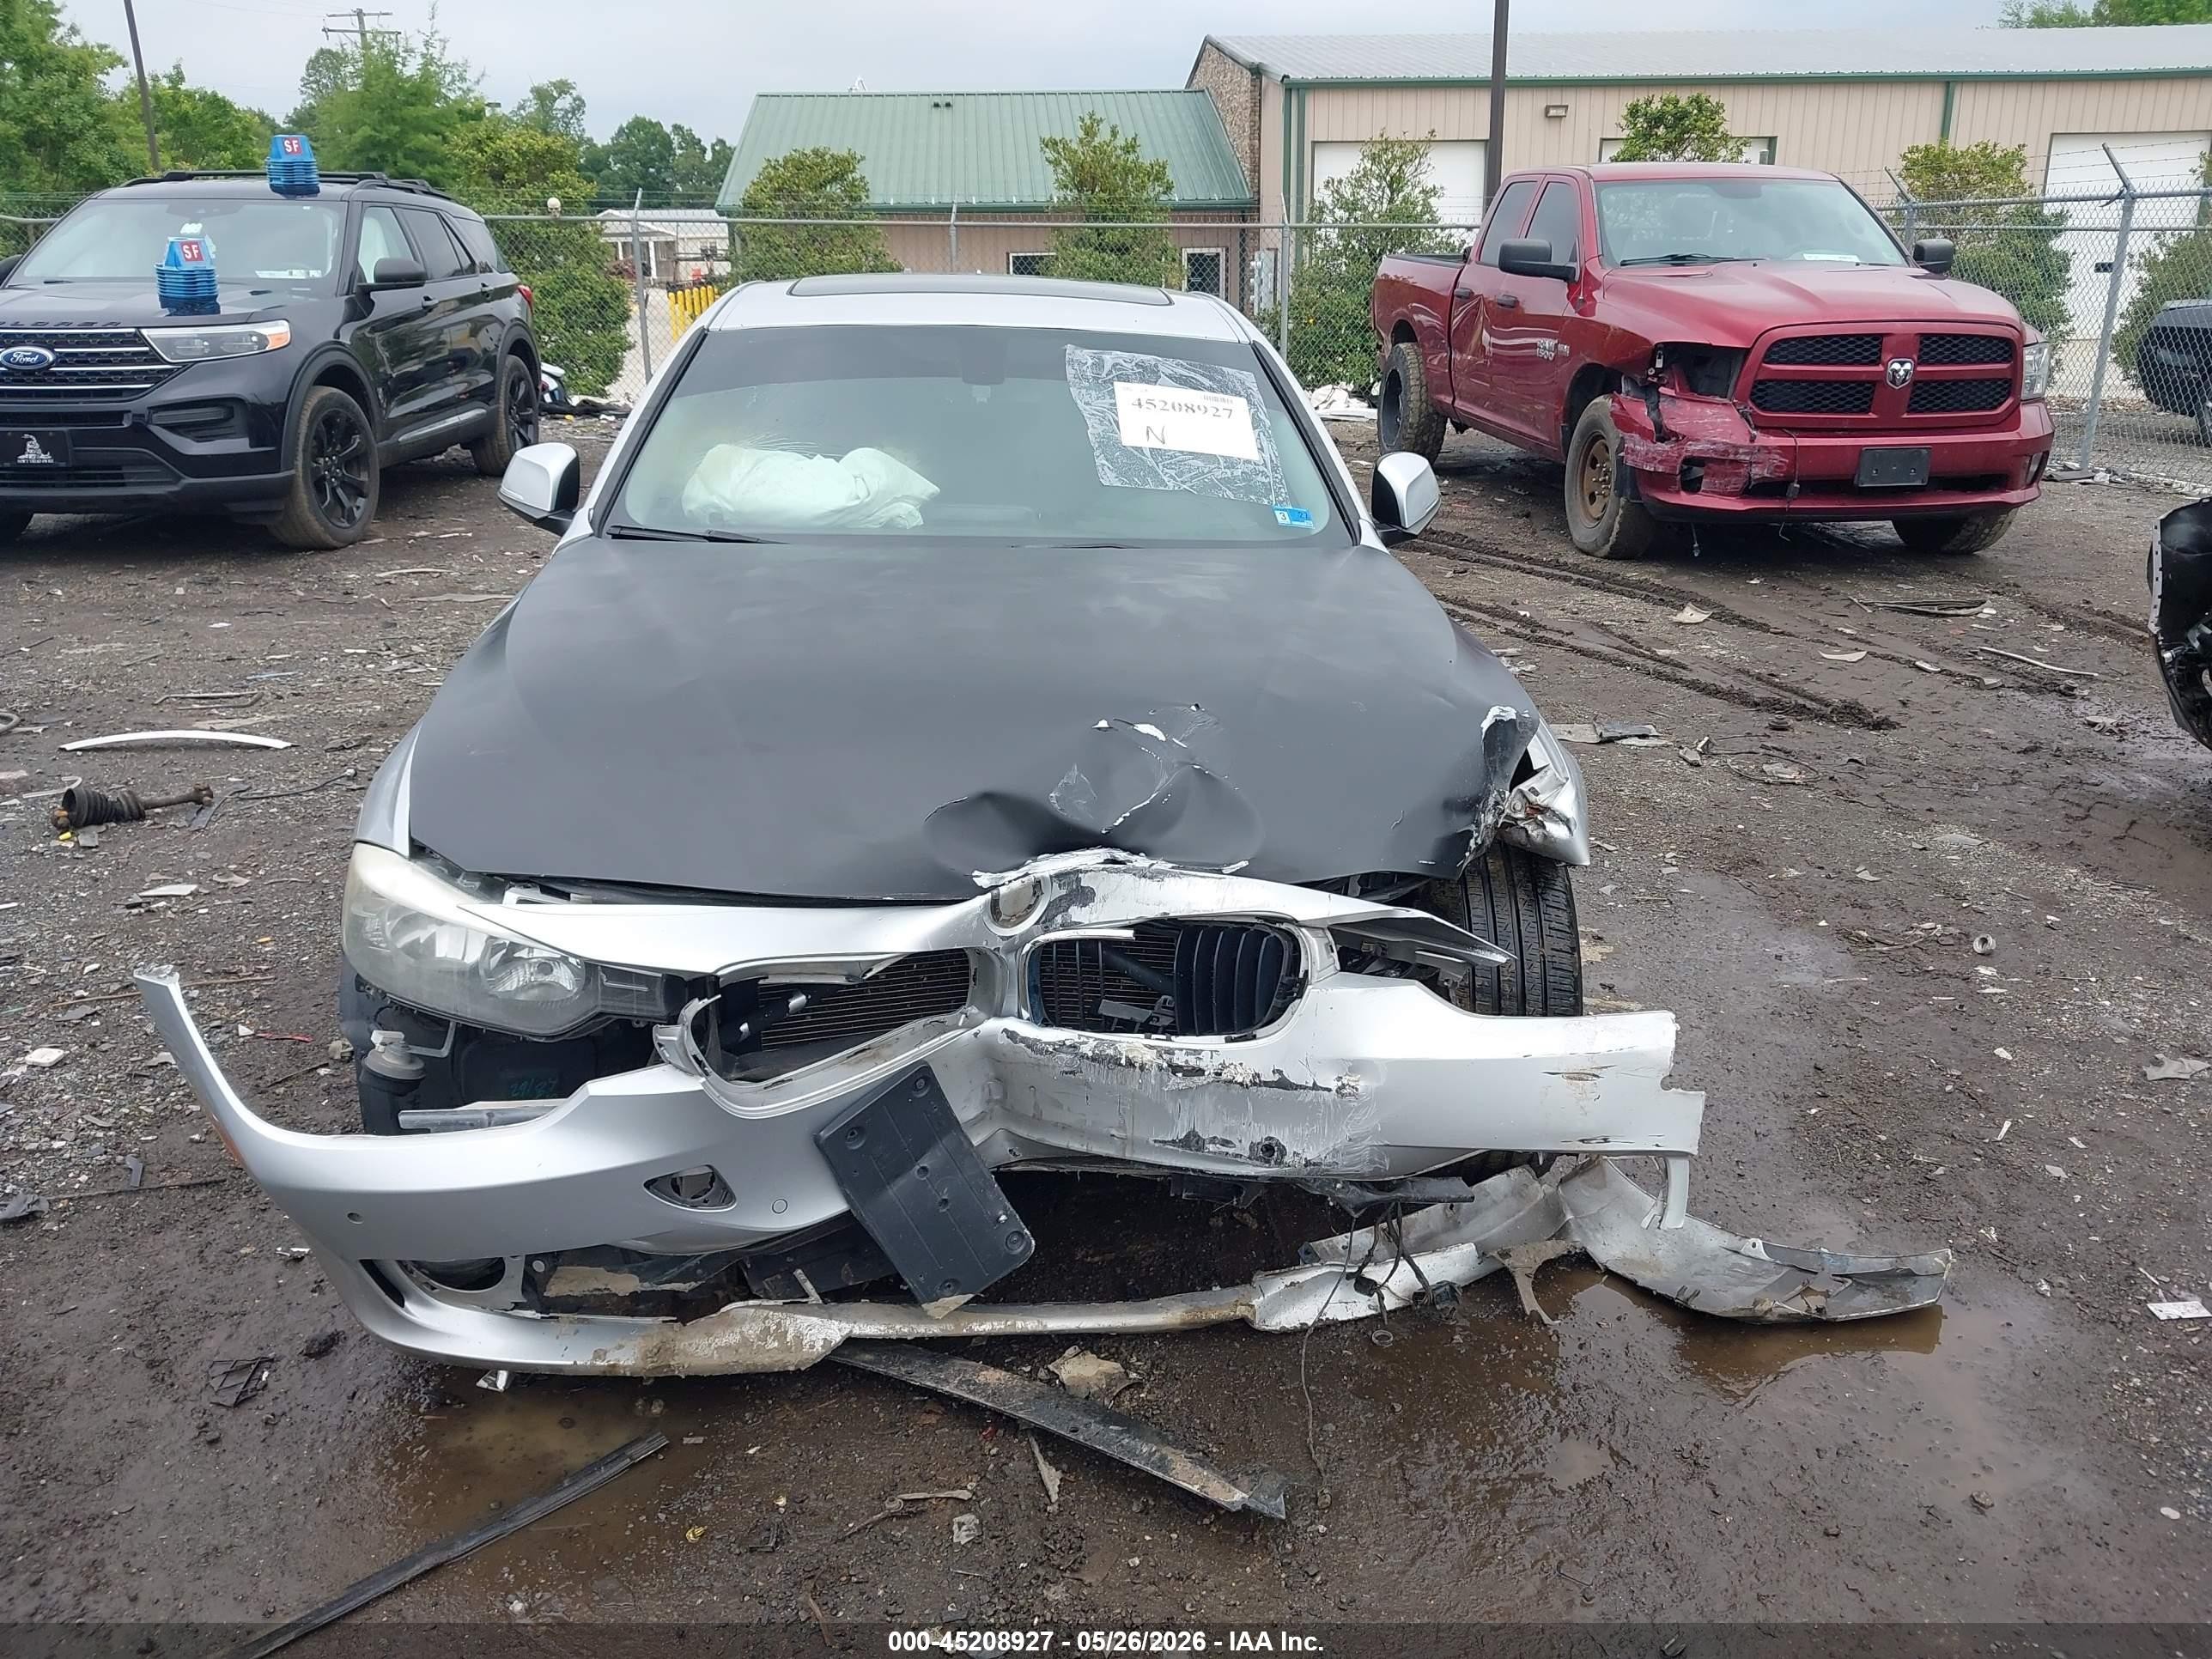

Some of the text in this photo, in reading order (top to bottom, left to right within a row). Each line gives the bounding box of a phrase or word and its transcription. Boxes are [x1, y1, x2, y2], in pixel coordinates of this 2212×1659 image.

[283, 139, 299, 153] SF
[183, 244, 199, 259] SF
[10, 352, 40, 363] Ford
[1132, 398, 1232, 418] 45208927
[1146, 425, 1165, 445] N
[1279, 512, 1286, 520] 3
